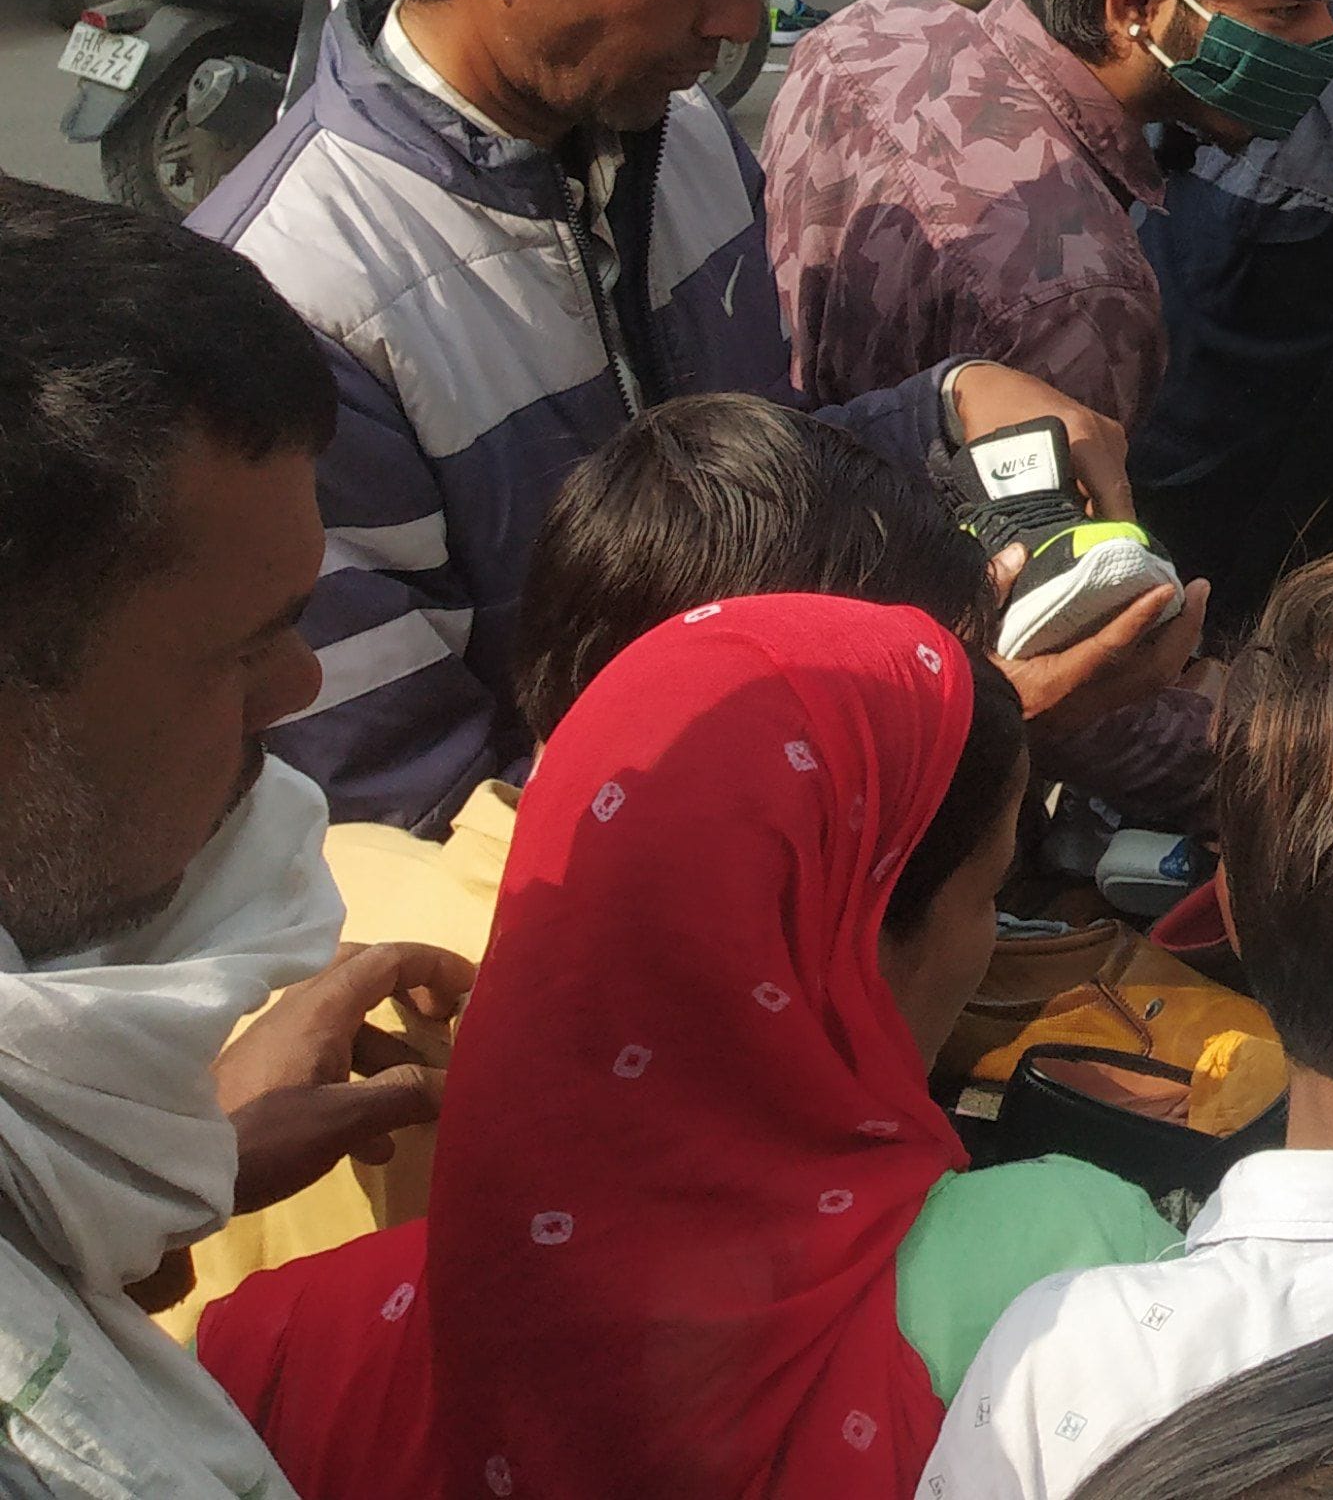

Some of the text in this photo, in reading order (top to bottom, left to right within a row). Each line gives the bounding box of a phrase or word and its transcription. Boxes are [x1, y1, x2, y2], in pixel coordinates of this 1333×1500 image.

[82, 31, 136, 61] HR 24
[1000, 452, 1038, 475] NIKE
